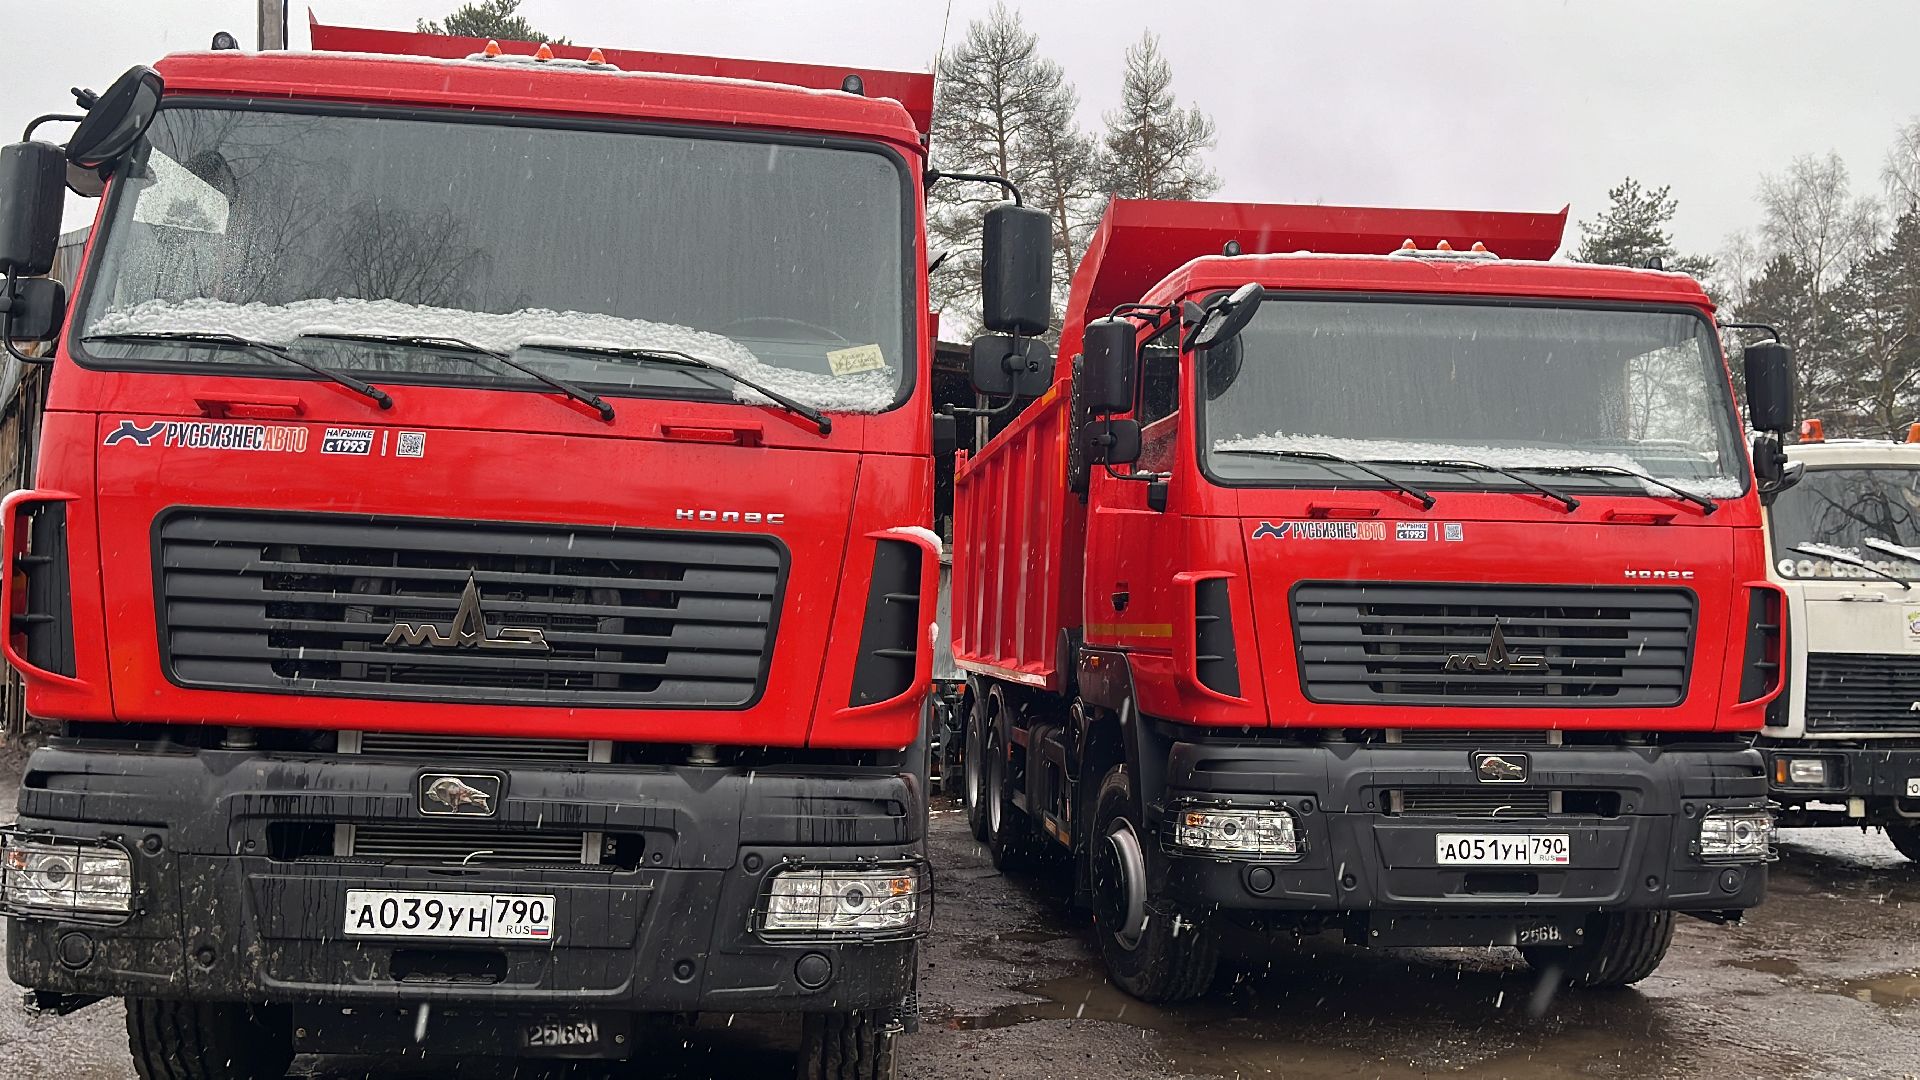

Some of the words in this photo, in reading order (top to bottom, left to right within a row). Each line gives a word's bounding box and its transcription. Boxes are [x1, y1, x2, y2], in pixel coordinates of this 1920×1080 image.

[165, 422, 309, 452] РУСБИЗНЕСАВТО
[326, 429, 339, 437] НА
[340, 430, 373, 439] РЫНКЕ
[336, 439, 367, 453] 1993
[1293, 522, 1386, 540] РУСБИЗНЕСАВТО
[1405, 530, 1425, 539] 1993
[1532, 838, 1563, 854] 790
[495, 899, 545, 924] 790
[505, 924, 531, 935] RUS
